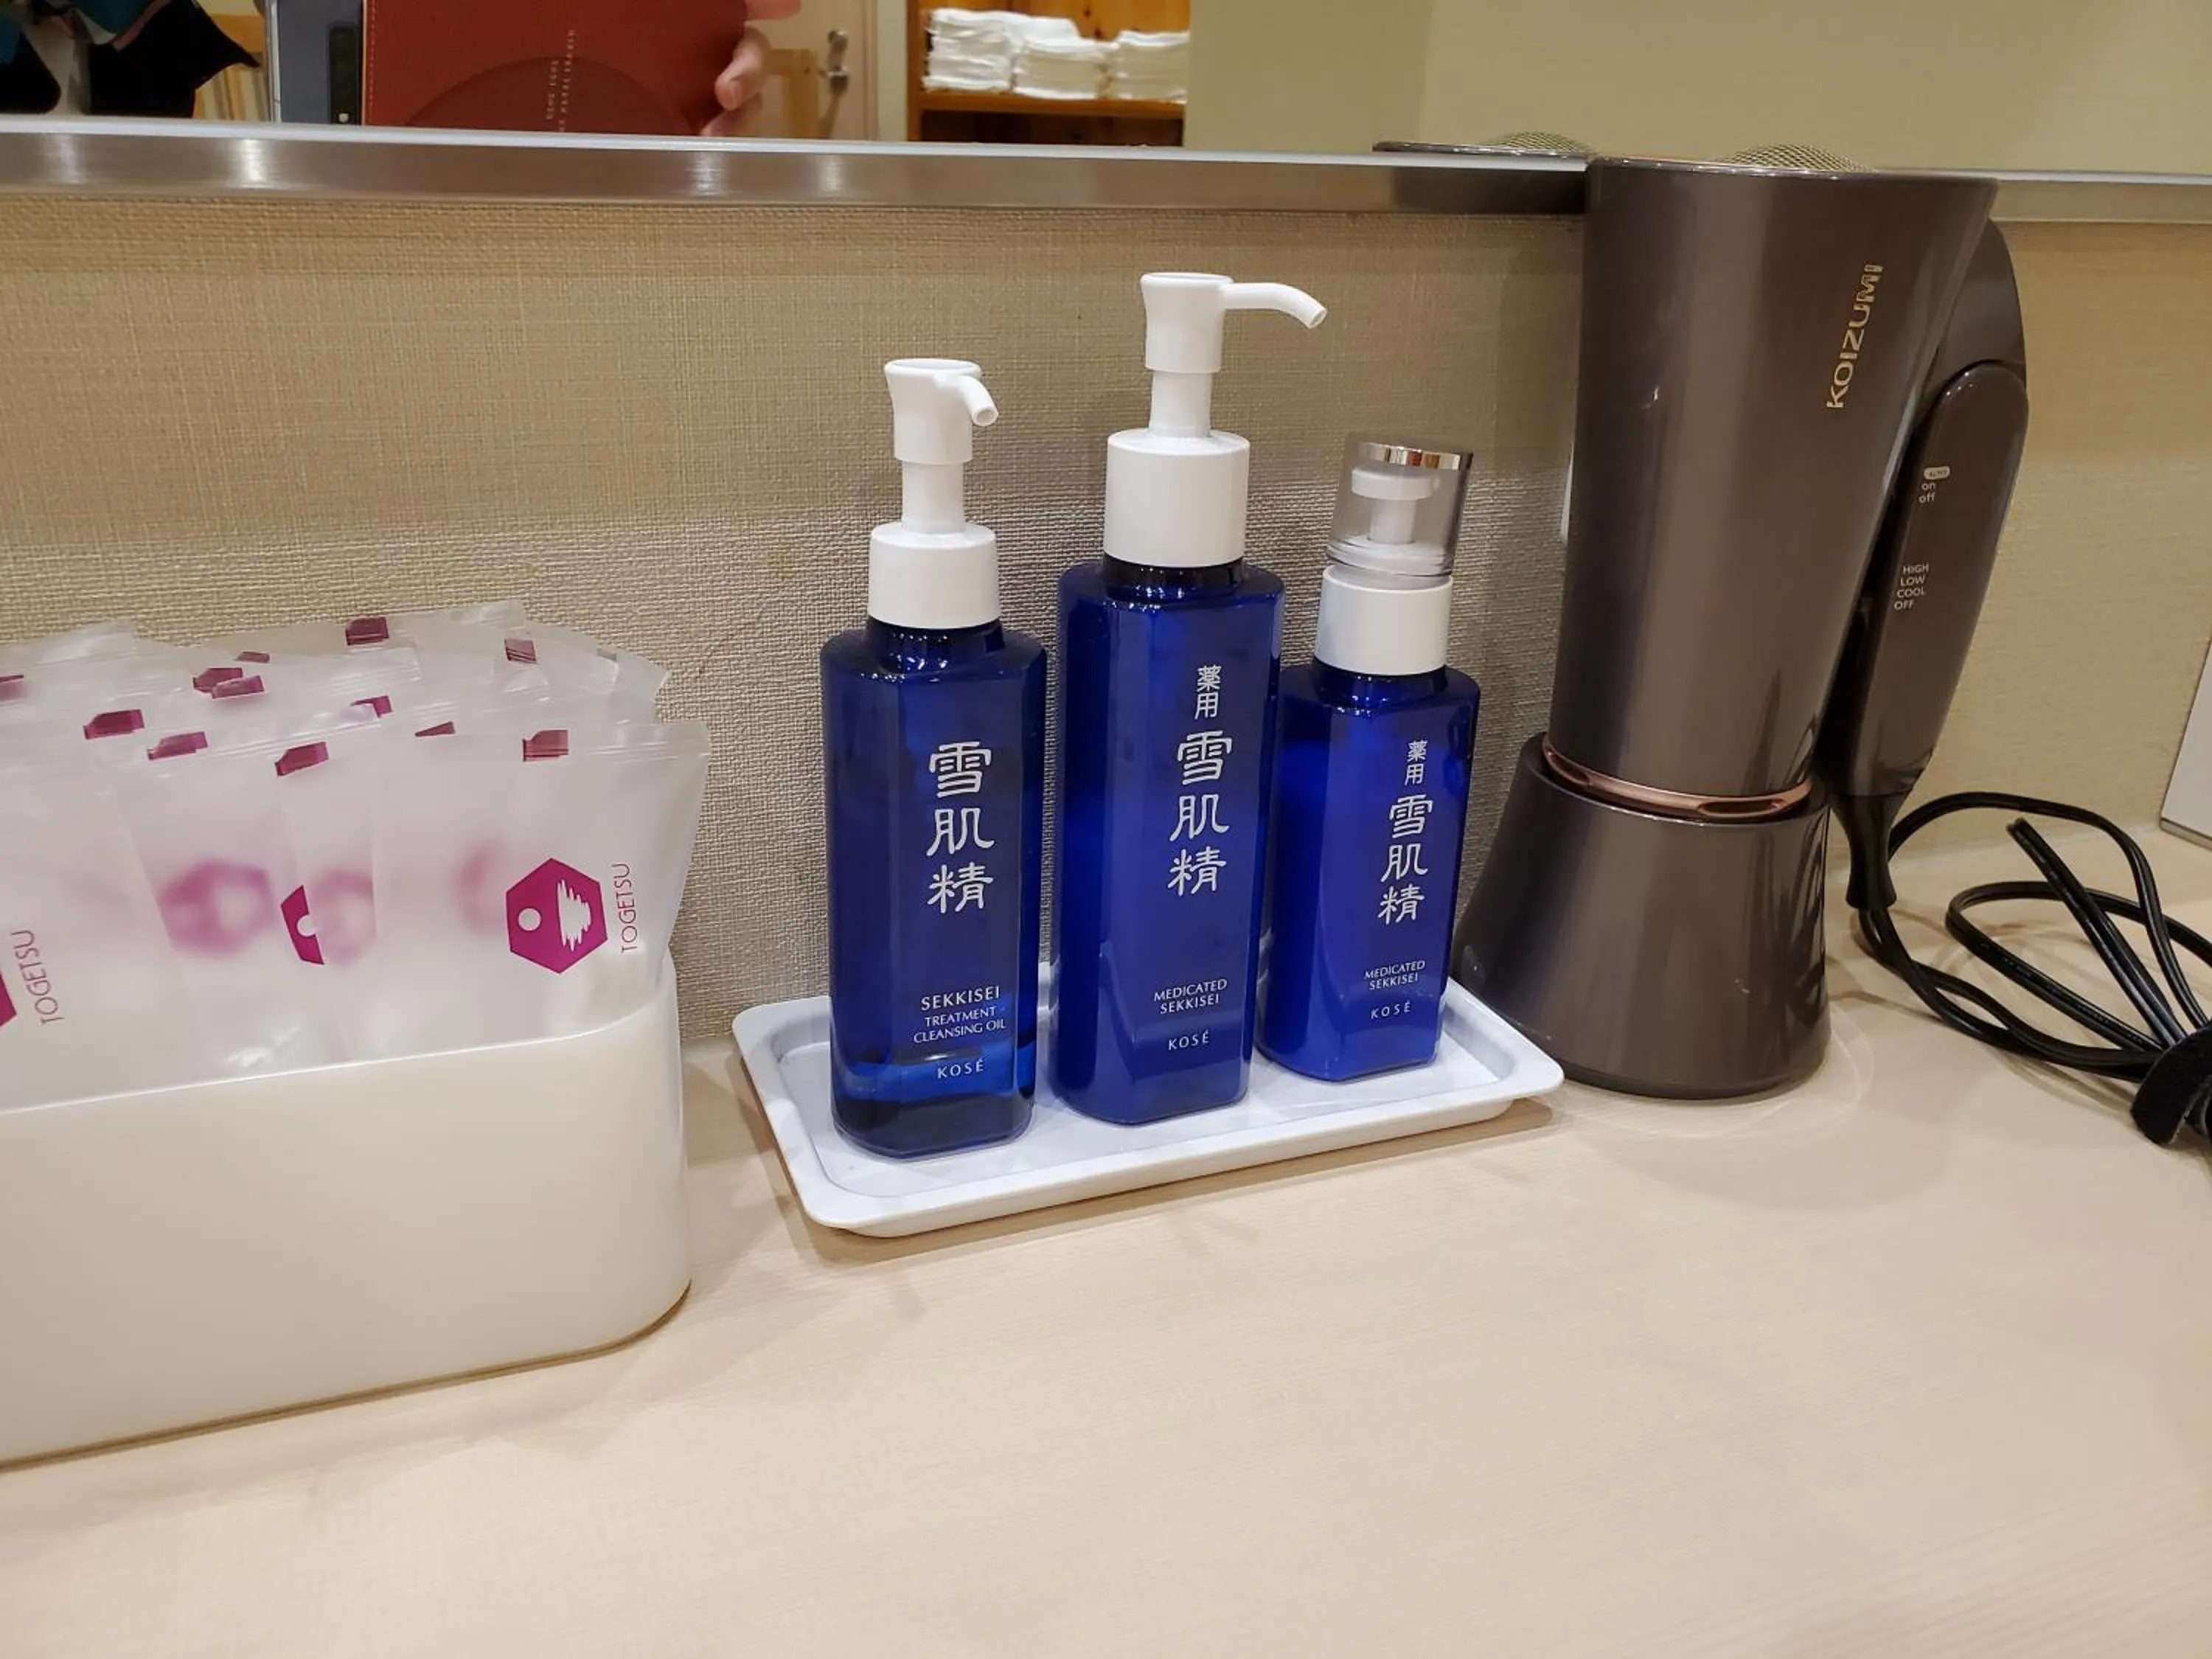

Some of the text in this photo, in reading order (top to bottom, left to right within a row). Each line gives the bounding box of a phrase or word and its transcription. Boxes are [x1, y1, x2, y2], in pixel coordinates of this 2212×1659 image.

[1826, 264, 1883, 408] KOIZUMI
[1921, 482, 1935, 491] on
[1919, 492, 1935, 504] off
[1902, 563, 1930, 574] HIGH
[1900, 574, 1926, 586] LOW
[1896, 587, 1925, 599] COOL
[1893, 599, 1915, 611] OFF
[1167, 730, 1233, 897] 雪肌精
[926, 740, 995, 914] 雪肌精
[1377, 793, 1434, 926] 雪肌精
[611, 863, 639, 954] TOGETSU
[10, 929, 65, 1026] TOGETSU
[1363, 960, 1426, 980] MEDICATED
[1368, 972, 1419, 990] SEKKISEI
[921, 985, 1001, 1012] SEKKISEI
[1153, 978, 1228, 1002] MEDICATED
[1160, 993, 1220, 1015] SEKKISEI
[1371, 1000, 1411, 1019] KOSÉ
[924, 1005, 998, 1028] TREATMENT
[913, 1018, 1006, 1043] CLEANSING OIL
[1168, 1029, 1210, 1051] KOSÉ
[936, 1057, 985, 1079] KOSÉ
